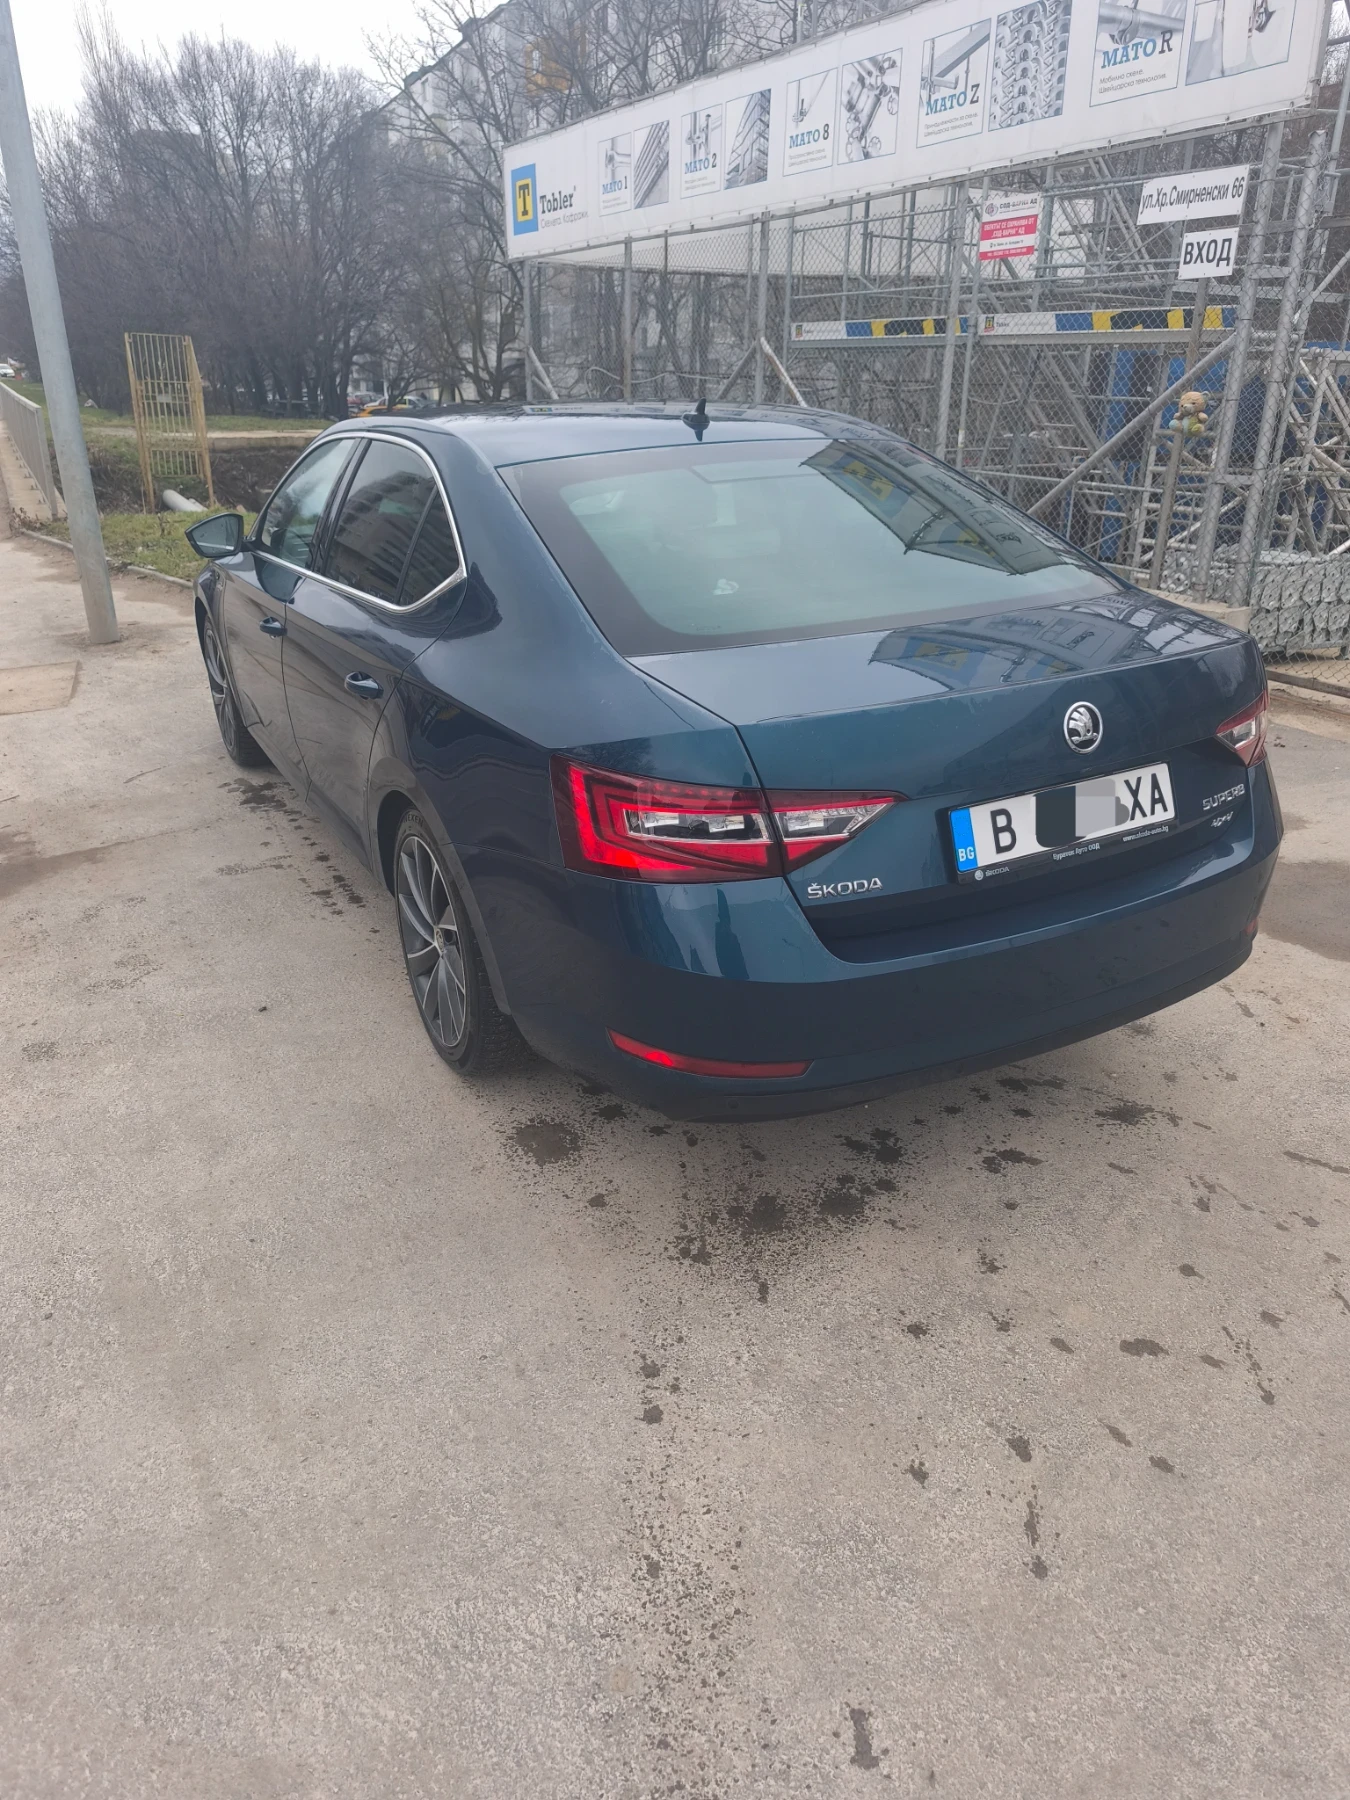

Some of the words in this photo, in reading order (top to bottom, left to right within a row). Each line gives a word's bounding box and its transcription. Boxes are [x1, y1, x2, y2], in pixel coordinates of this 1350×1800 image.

[1101, 37, 1157, 69] MATO
[1158, 29, 1173, 55] R
[925, 90, 967, 116] MATO
[969, 83, 981, 105] Z
[789, 128, 821, 149] MATO
[822, 123, 830, 141] 8
[684, 157, 710, 174] MATO
[711, 152, 717, 169] 2
[602, 179, 623, 195] MATO
[624, 175, 628, 190] 1
[1140, 183, 1230, 215] ул.Хр.Смирненски
[1231, 176, 1245, 199] 66
[518, 182, 530, 217] T
[539, 190, 574, 214] Tobler
[1182, 237, 1233, 268] ВХОД
[1202, 783, 1246, 811] SUPERB
[990, 807, 1017, 855] B
[1123, 772, 1169, 822] XA
[957, 846, 975, 863] BG
[807, 877, 884, 899] ŠKODA
